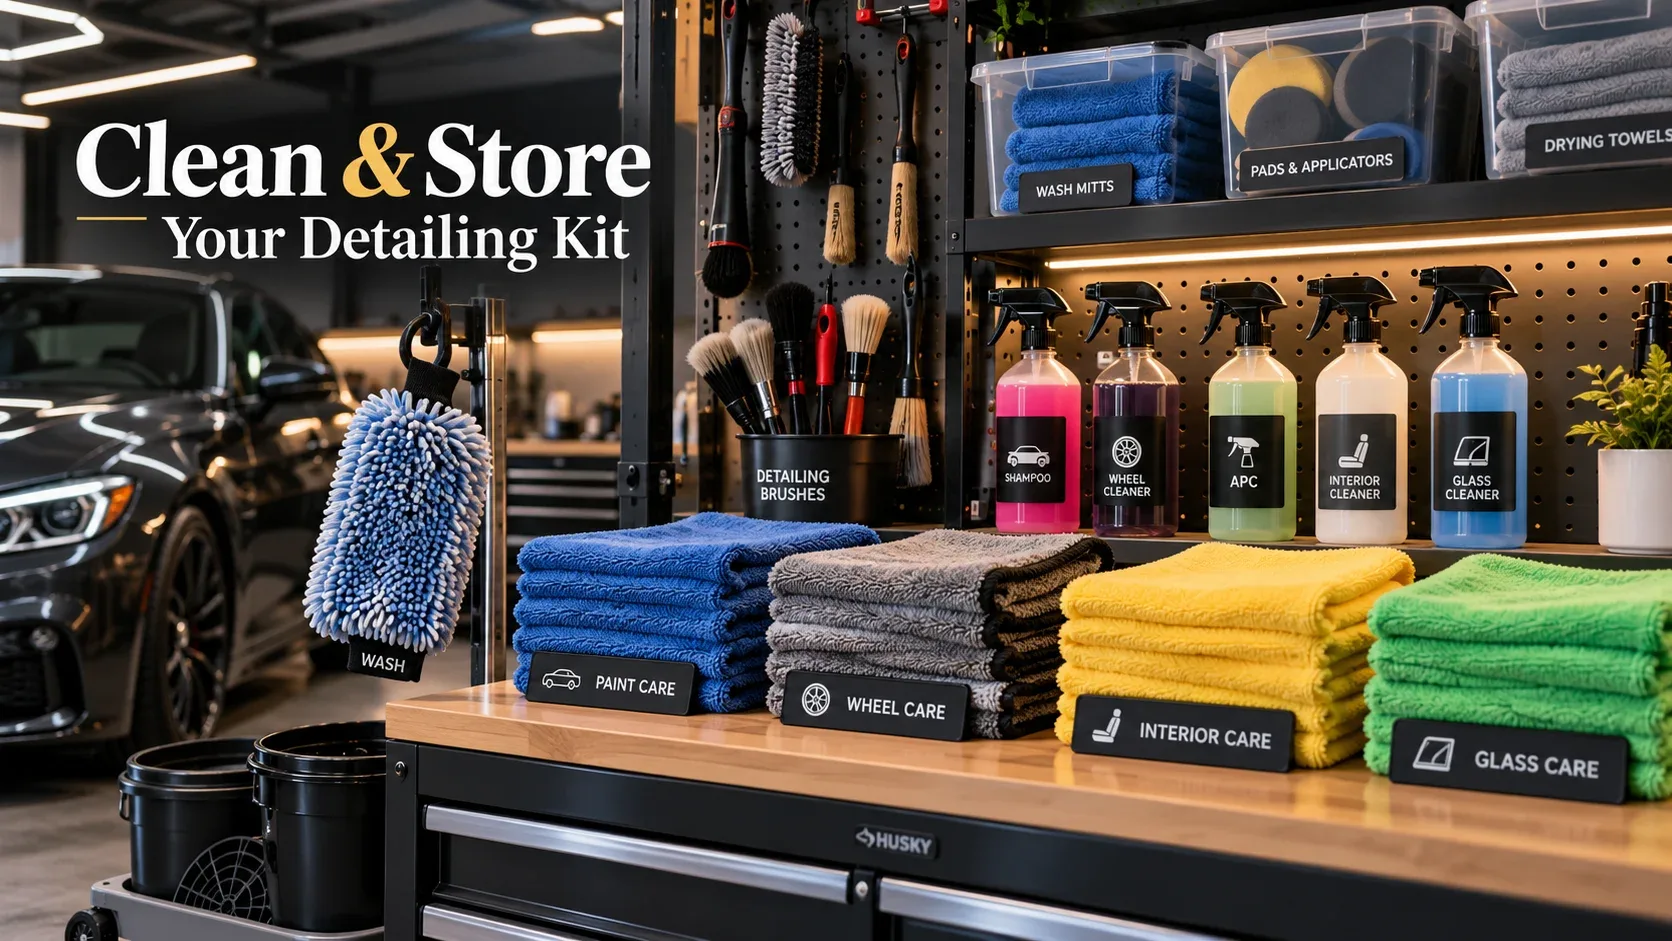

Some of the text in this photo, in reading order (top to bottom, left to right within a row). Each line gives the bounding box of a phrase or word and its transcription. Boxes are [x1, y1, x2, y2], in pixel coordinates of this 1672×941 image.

[1544, 128, 1672, 153] DRYING TOWELS
[1251, 153, 1394, 178] PADS & APPLICATORS
[1035, 179, 1114, 198] WASH MITTS
[755, 468, 830, 484] DETAILING
[1004, 472, 1052, 483] SHAMPOO
[1108, 473, 1146, 485] WHEEL
[1229, 474, 1258, 488] APC
[1329, 474, 1381, 487] INTERIOR
[1452, 474, 1492, 487] GLASS
[760, 486, 826, 502] BRUSHES
[1103, 486, 1151, 497] CLEANER
[1329, 488, 1381, 500] CLEANER
[1445, 488, 1500, 500] CLEANER
[361, 652, 406, 673] WASH
[595, 675, 676, 697] PAINT CARE
[847, 696, 946, 721] WHEEL CARE
[1139, 722, 1272, 750] INTERIOR CARE
[1474, 750, 1600, 779] GLASS CARE
[876, 831, 933, 855] HUSKY
